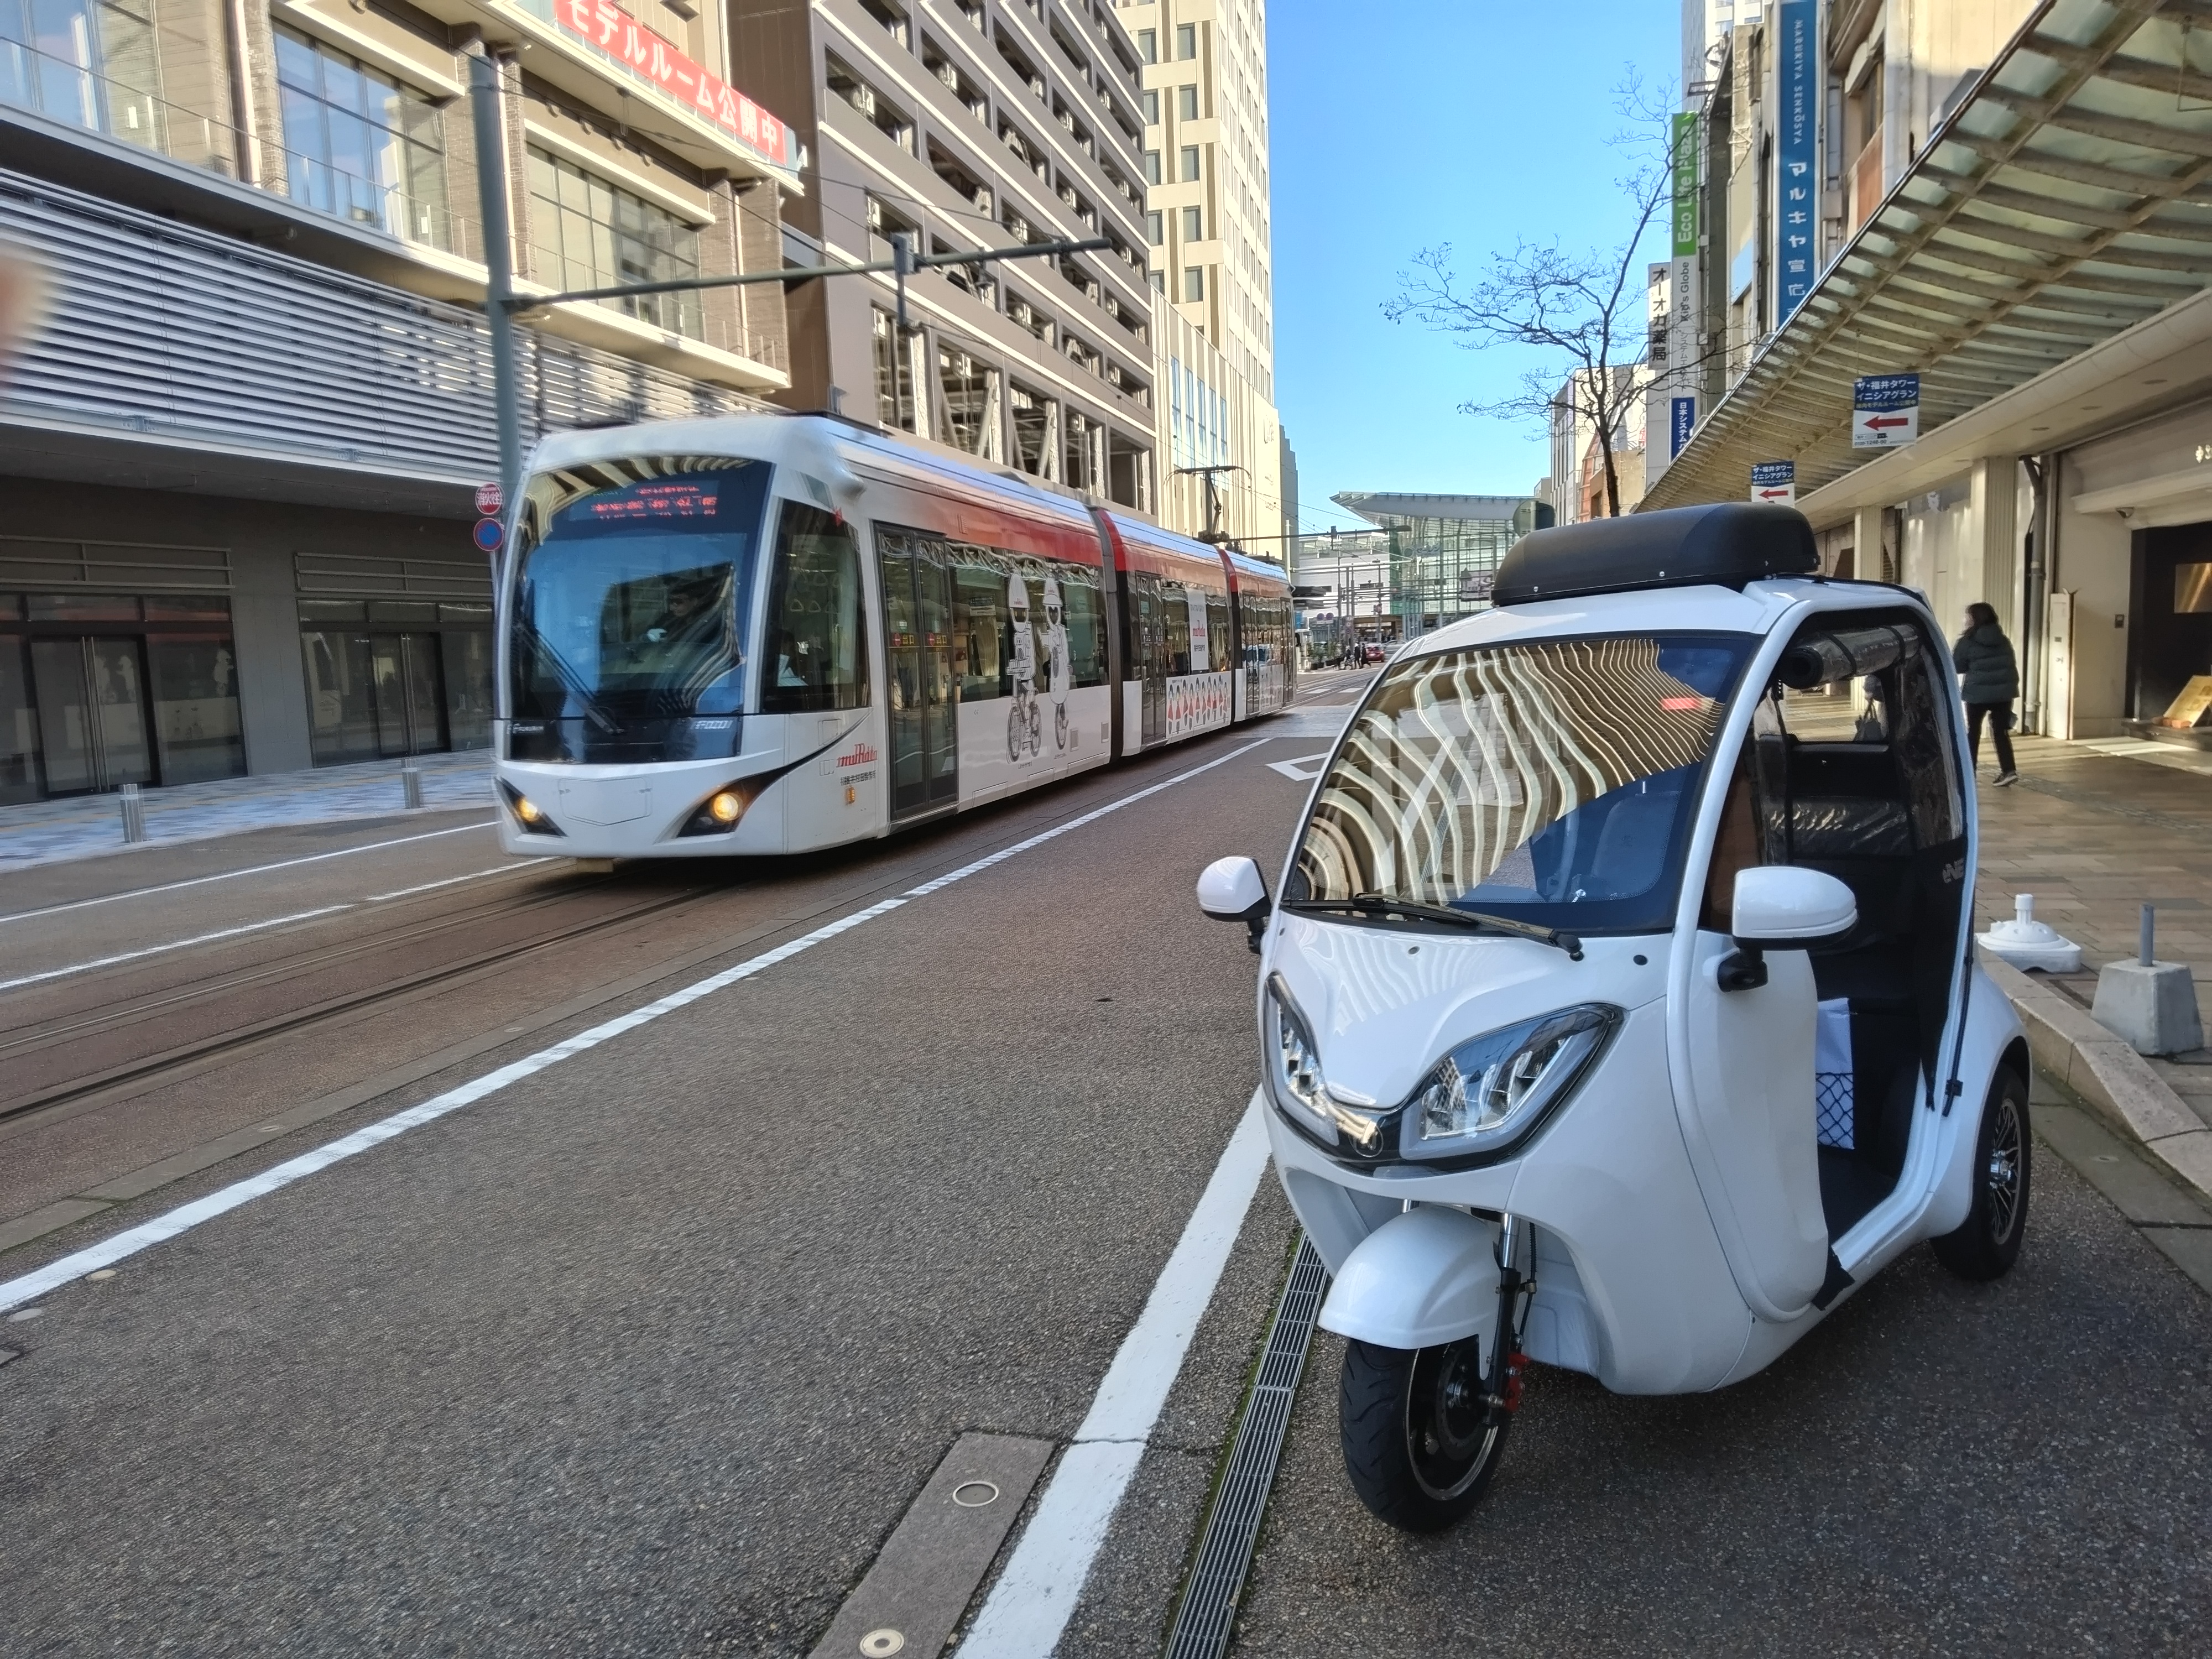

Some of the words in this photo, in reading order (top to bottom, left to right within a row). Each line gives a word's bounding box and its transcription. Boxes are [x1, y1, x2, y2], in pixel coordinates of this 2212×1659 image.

[1794, 19, 1804, 80] MARUKIYA
[568, 0, 778, 154] モデルルーム公開中
[1678, 125, 1692, 171] Plaza
[1678, 176, 1692, 207] Life
[1678, 212, 1692, 242] Eco
[1788, 162, 1807, 316] マルキヤ宣広
[1680, 262, 1689, 293] Globe
[1652, 268, 1667, 362] オーオカ薬局
[1856, 379, 1916, 390] ザ・福井タワー
[1857, 389, 1917, 401] イニシアグラン
[1752, 472, 1793, 481] イニシアグラン
[1753, 465, 1793, 473] ザ・福井タワー
[477, 492, 500, 506] 消火栓
